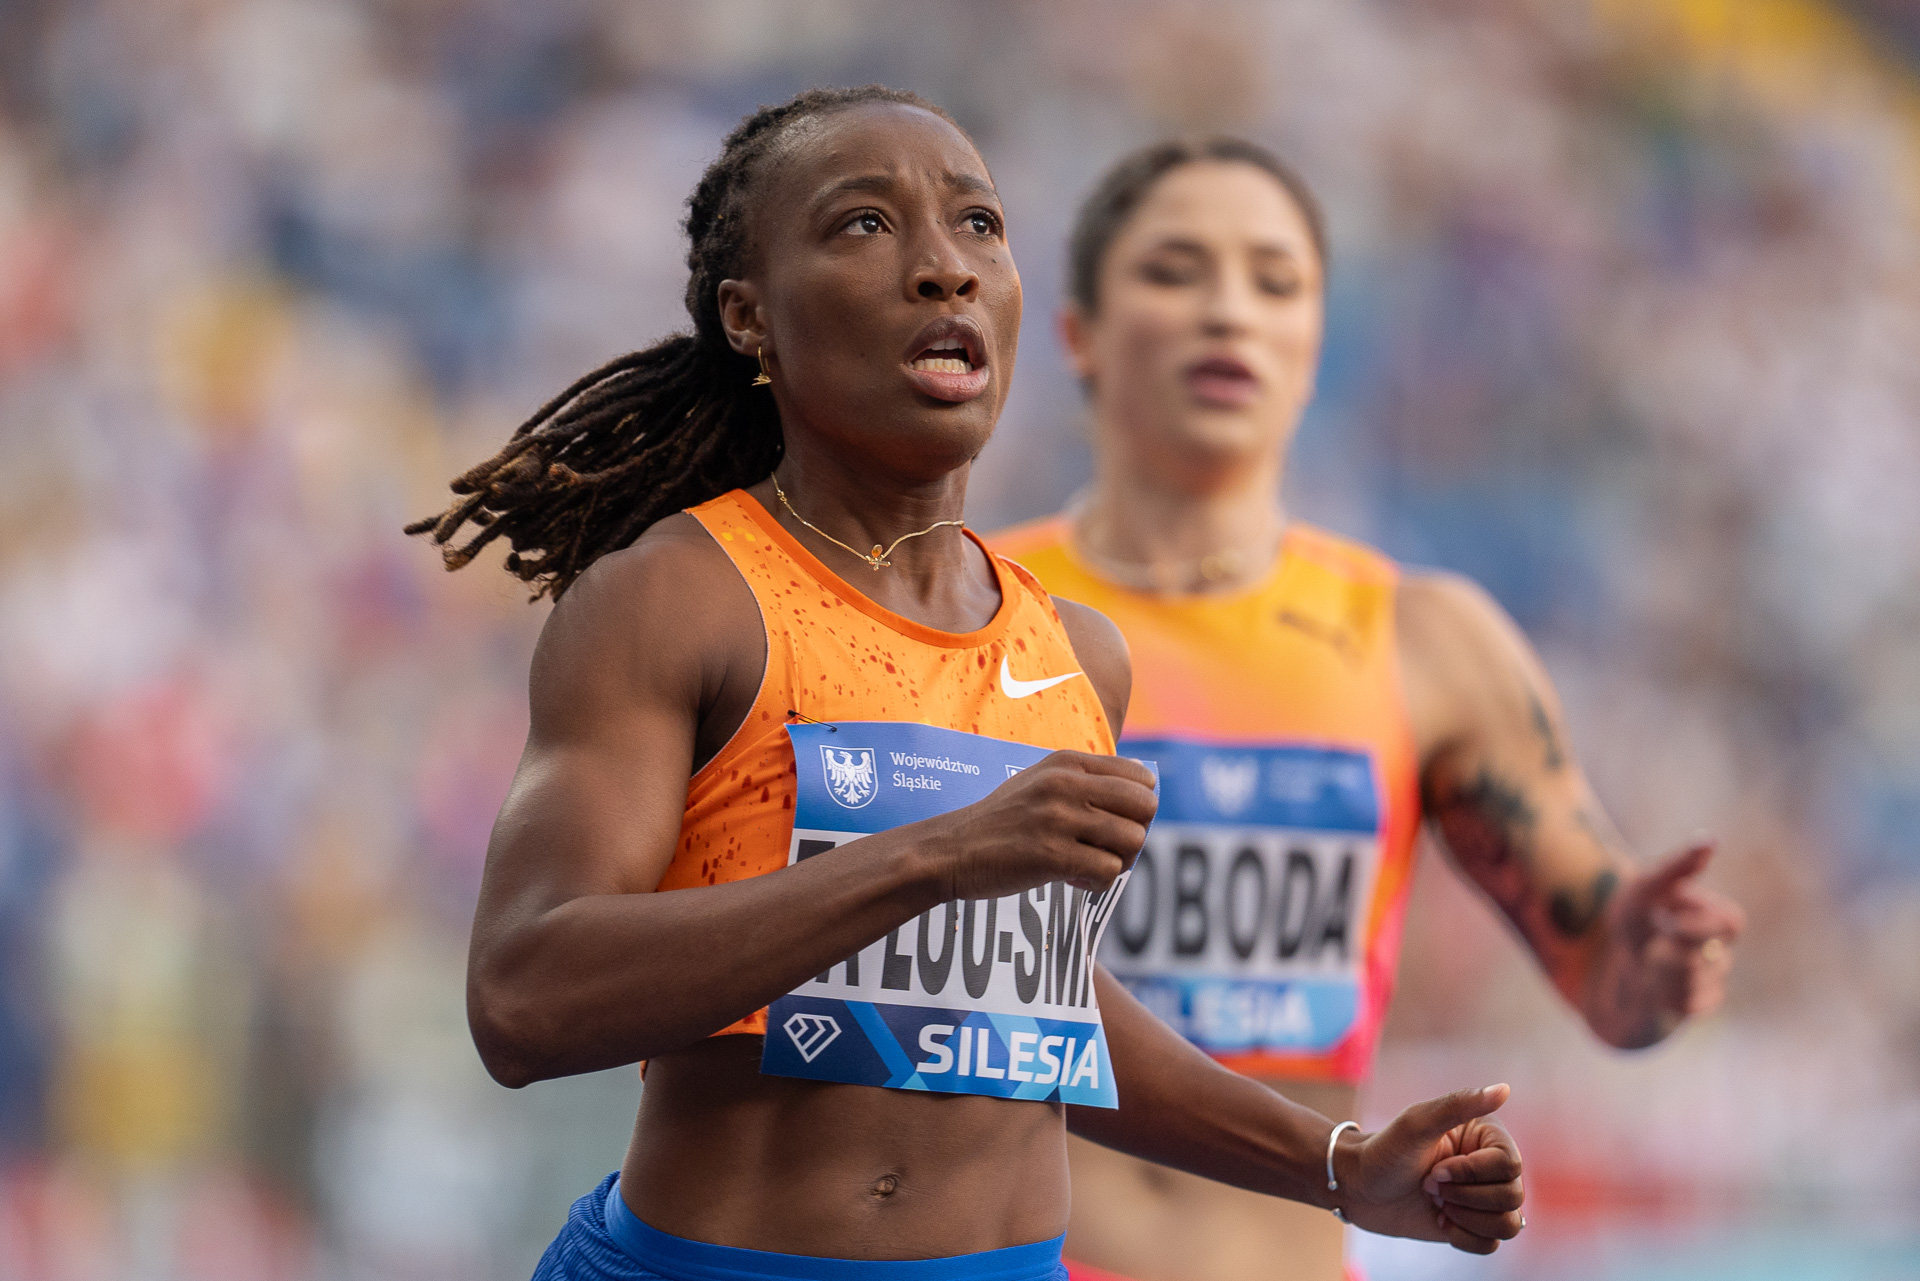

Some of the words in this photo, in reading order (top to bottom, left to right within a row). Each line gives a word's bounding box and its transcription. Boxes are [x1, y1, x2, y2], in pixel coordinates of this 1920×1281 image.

[889, 752, 981, 776] Województwo
[892, 770, 942, 792] Śląskie
[916, 1023, 1099, 1090] SILESIA
